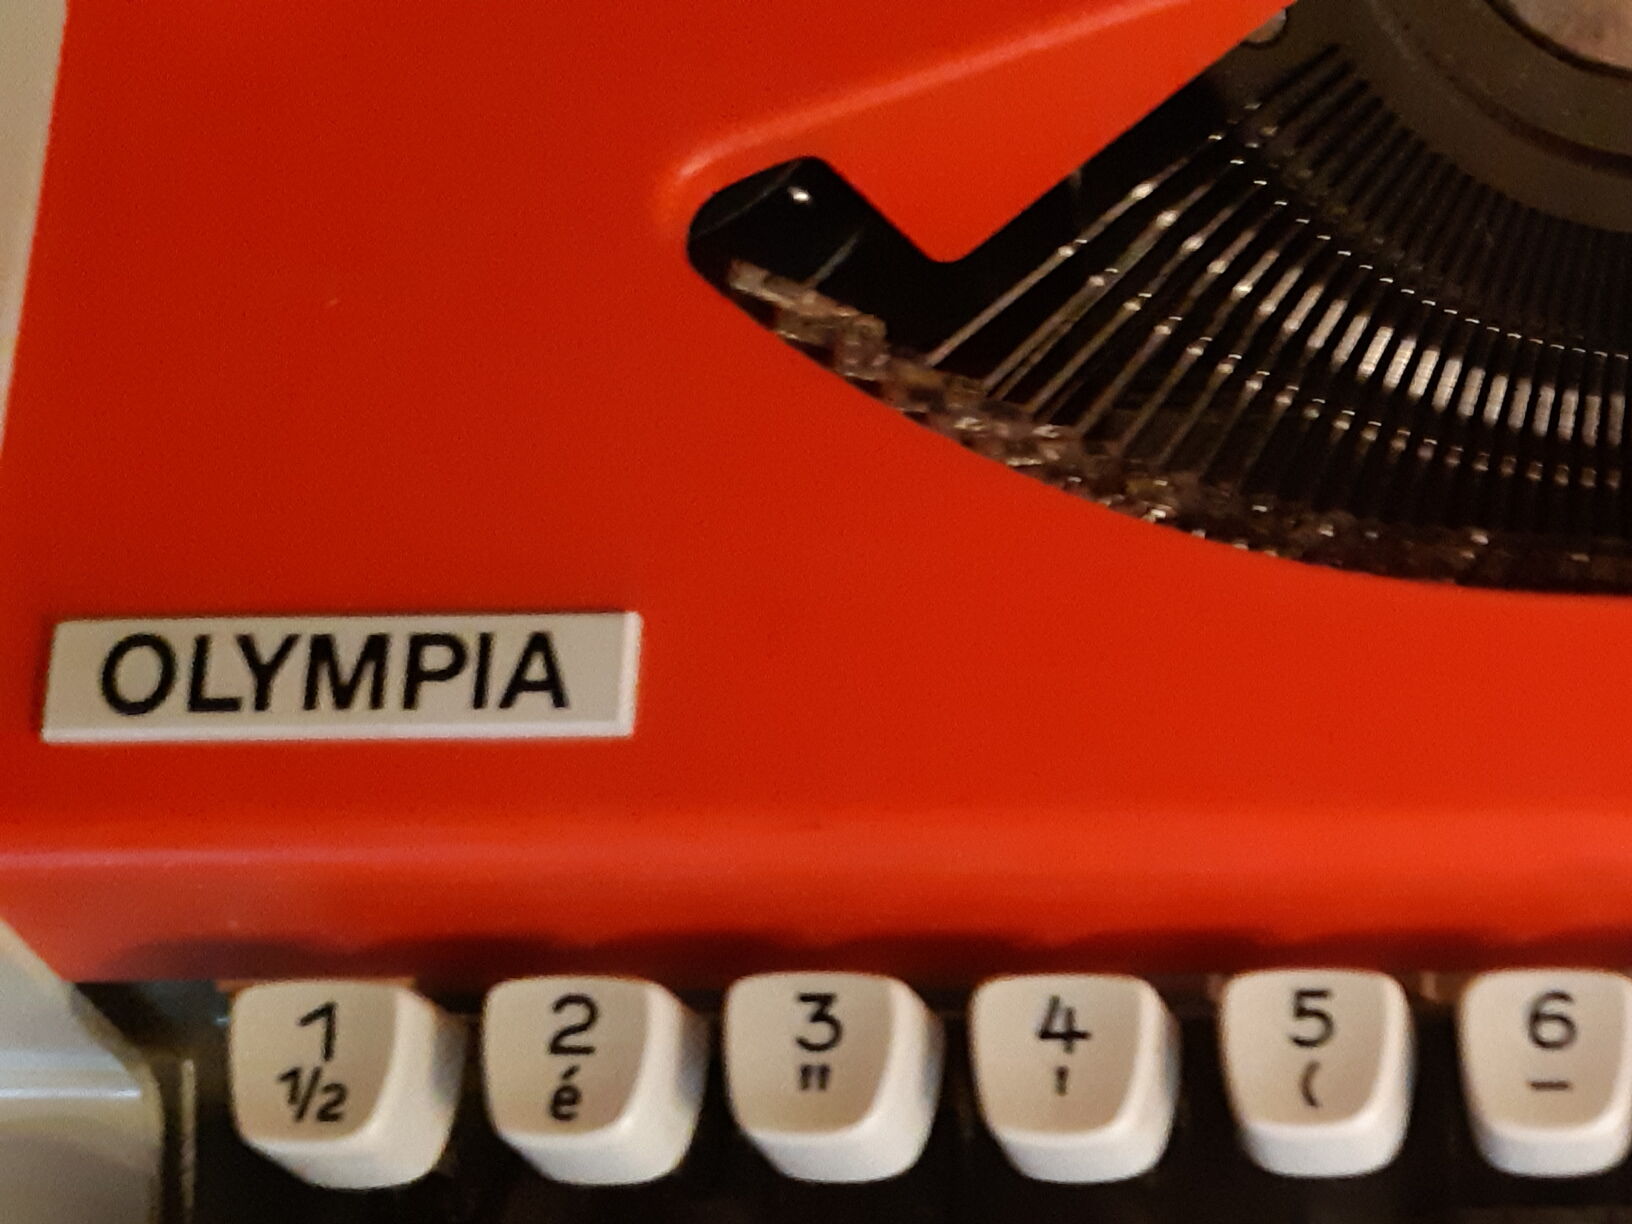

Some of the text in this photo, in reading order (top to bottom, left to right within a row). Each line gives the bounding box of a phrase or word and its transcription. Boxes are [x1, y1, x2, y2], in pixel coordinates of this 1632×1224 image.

[98, 630, 569, 717] OLYMPIA
[299, 1001, 337, 1063] 1
[547, 993, 600, 1057] 2
[795, 992, 844, 1054] 3
[1037, 996, 1092, 1054] 4
[1291, 988, 1334, 1049] 5
[1527, 990, 1577, 1051] 6
[548, 1065, 583, 1123] é
